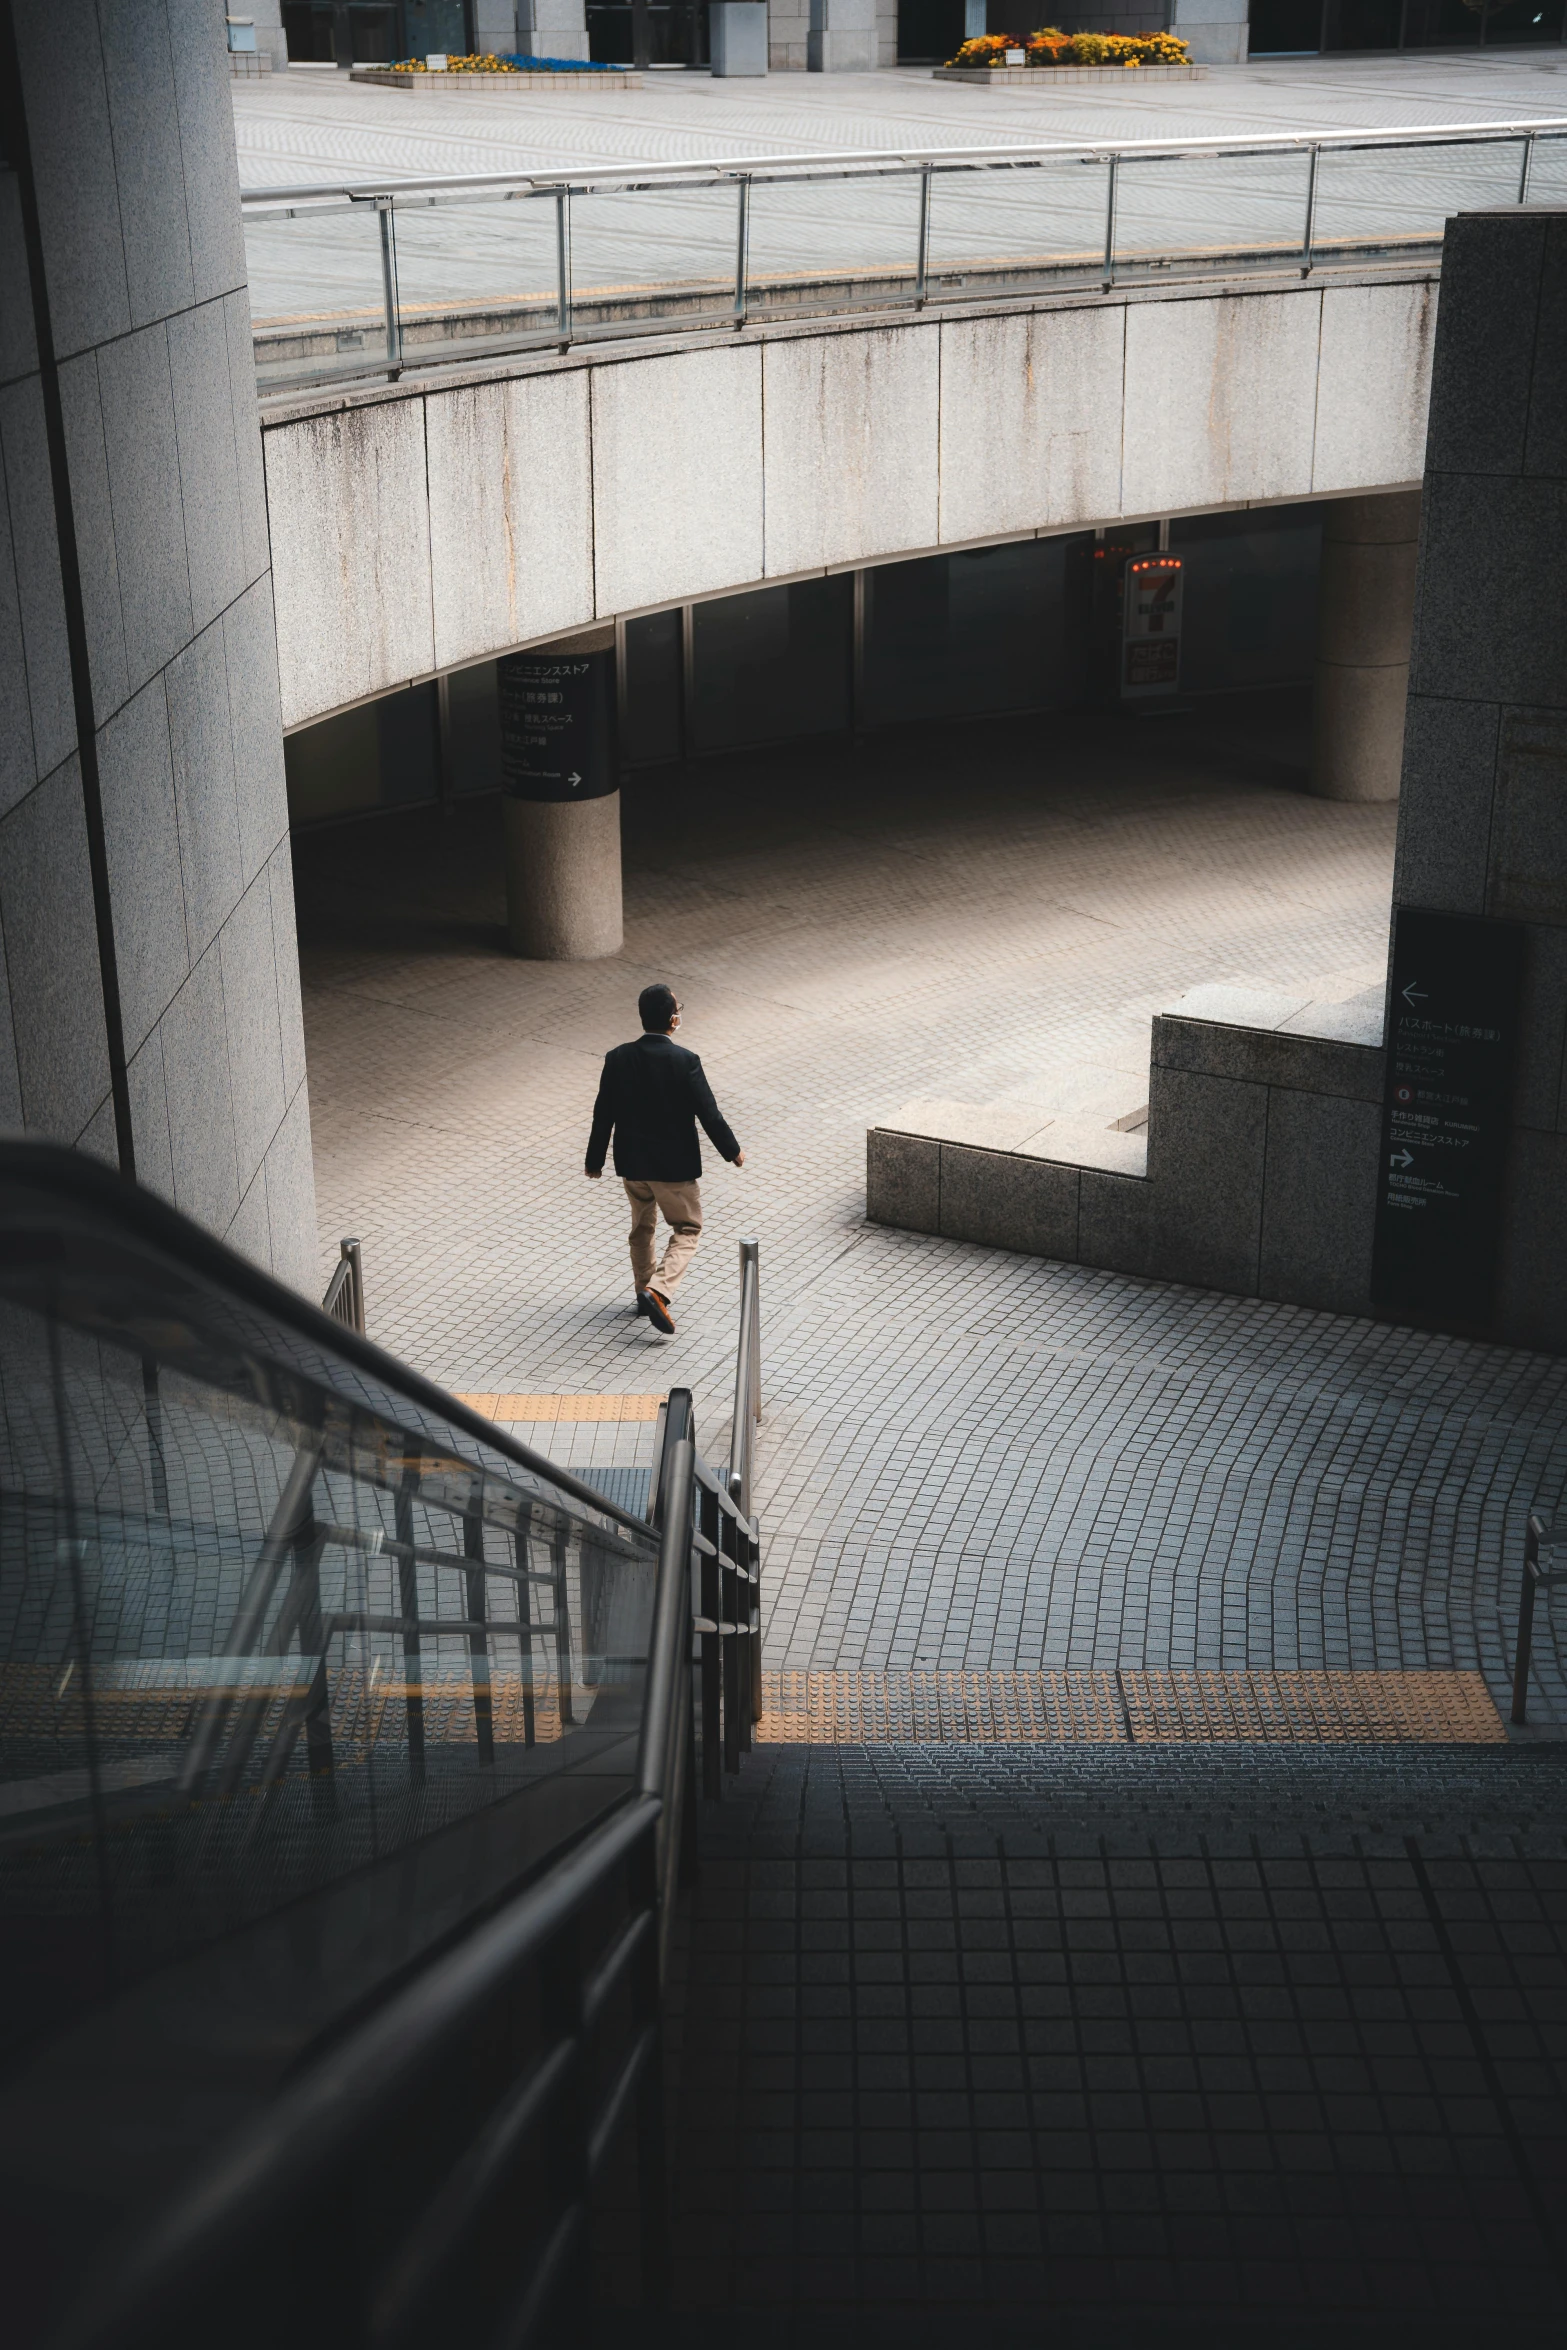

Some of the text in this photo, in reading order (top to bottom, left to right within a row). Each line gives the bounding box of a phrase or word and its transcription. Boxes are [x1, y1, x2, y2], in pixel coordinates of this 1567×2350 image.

[1138, 574, 1175, 632] 7
[1389, 1127, 1470, 1148] コンビニエンスストア
